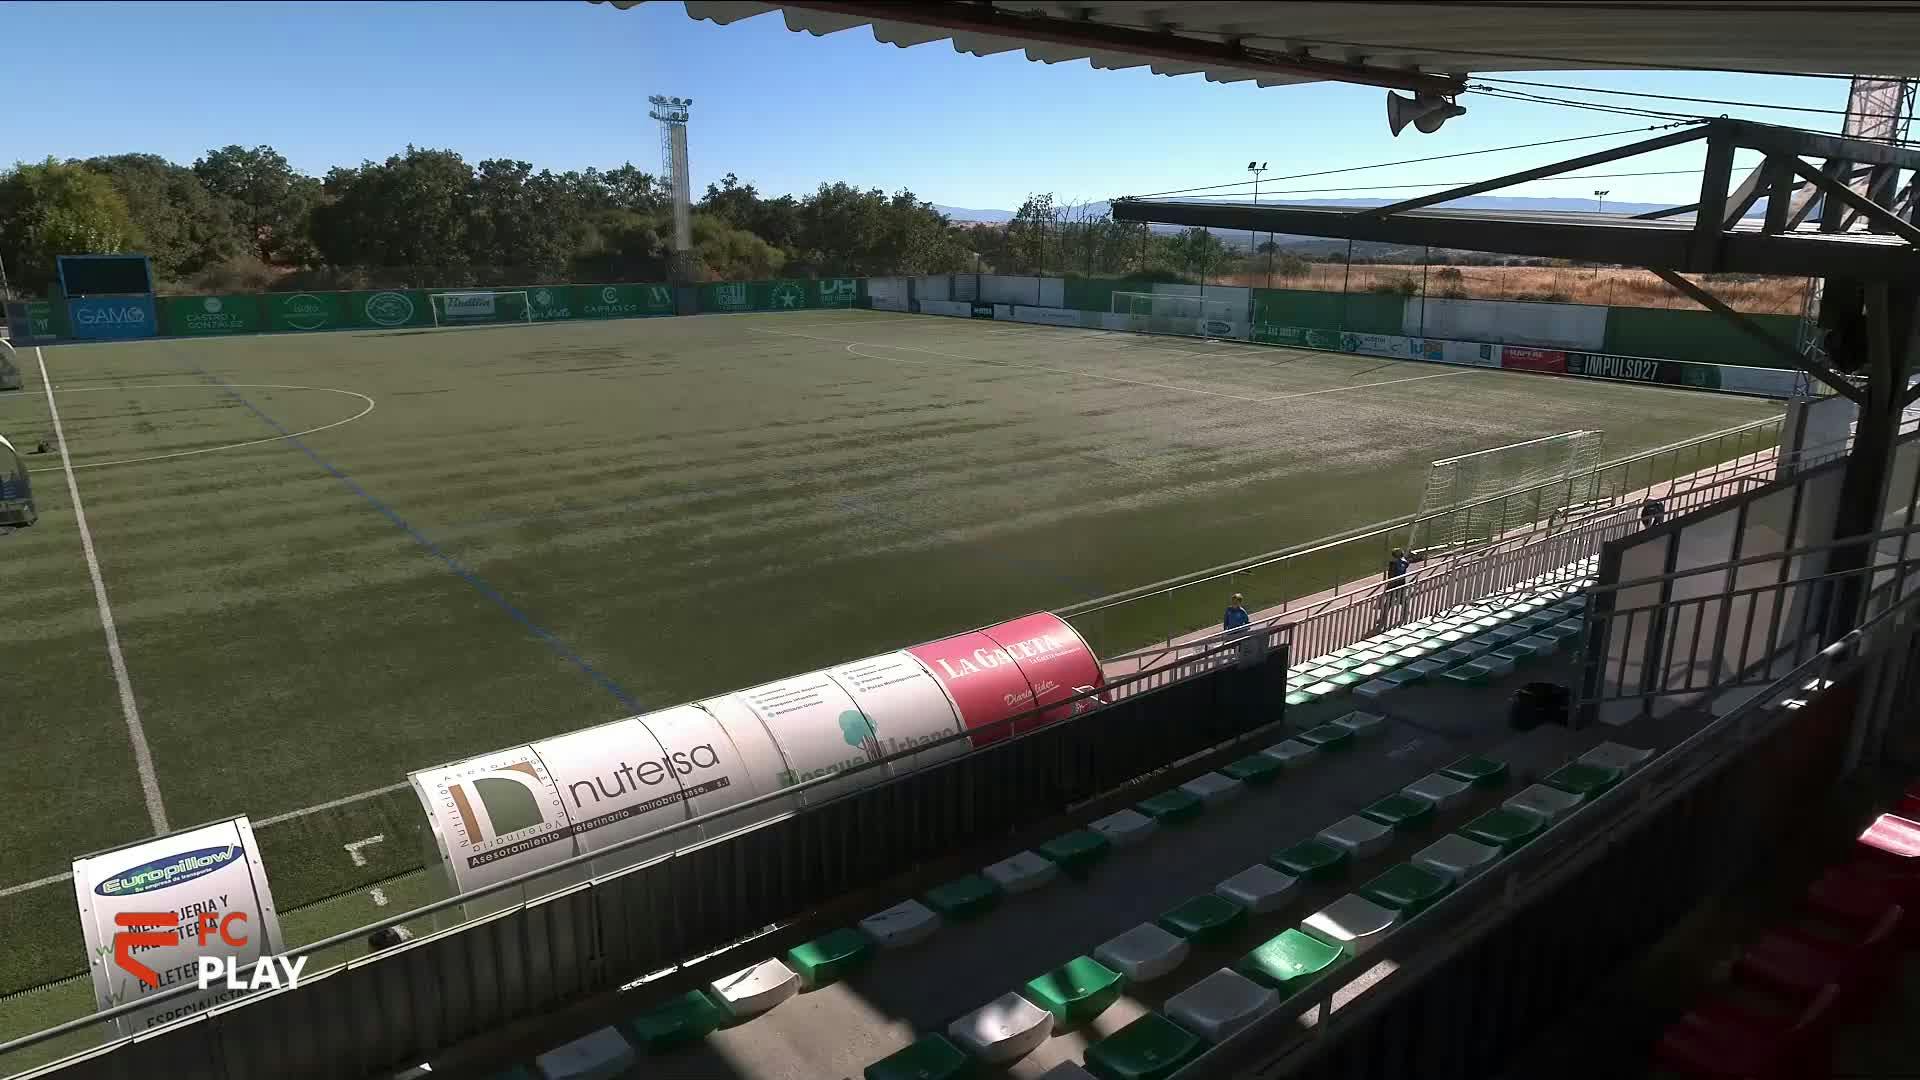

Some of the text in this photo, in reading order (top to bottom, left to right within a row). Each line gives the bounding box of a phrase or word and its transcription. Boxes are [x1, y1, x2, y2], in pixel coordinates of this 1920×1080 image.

[1584, 355, 1659, 379] IMPULSO27
[972, 635, 1063, 668] GACETA
[569, 743, 720, 808] nutersa
[472, 833, 560, 866] Asesoramiento
[103, 843, 235, 893] Europillow
[145, 879, 171, 890] empresa
[181, 868, 212, 880] transporte
